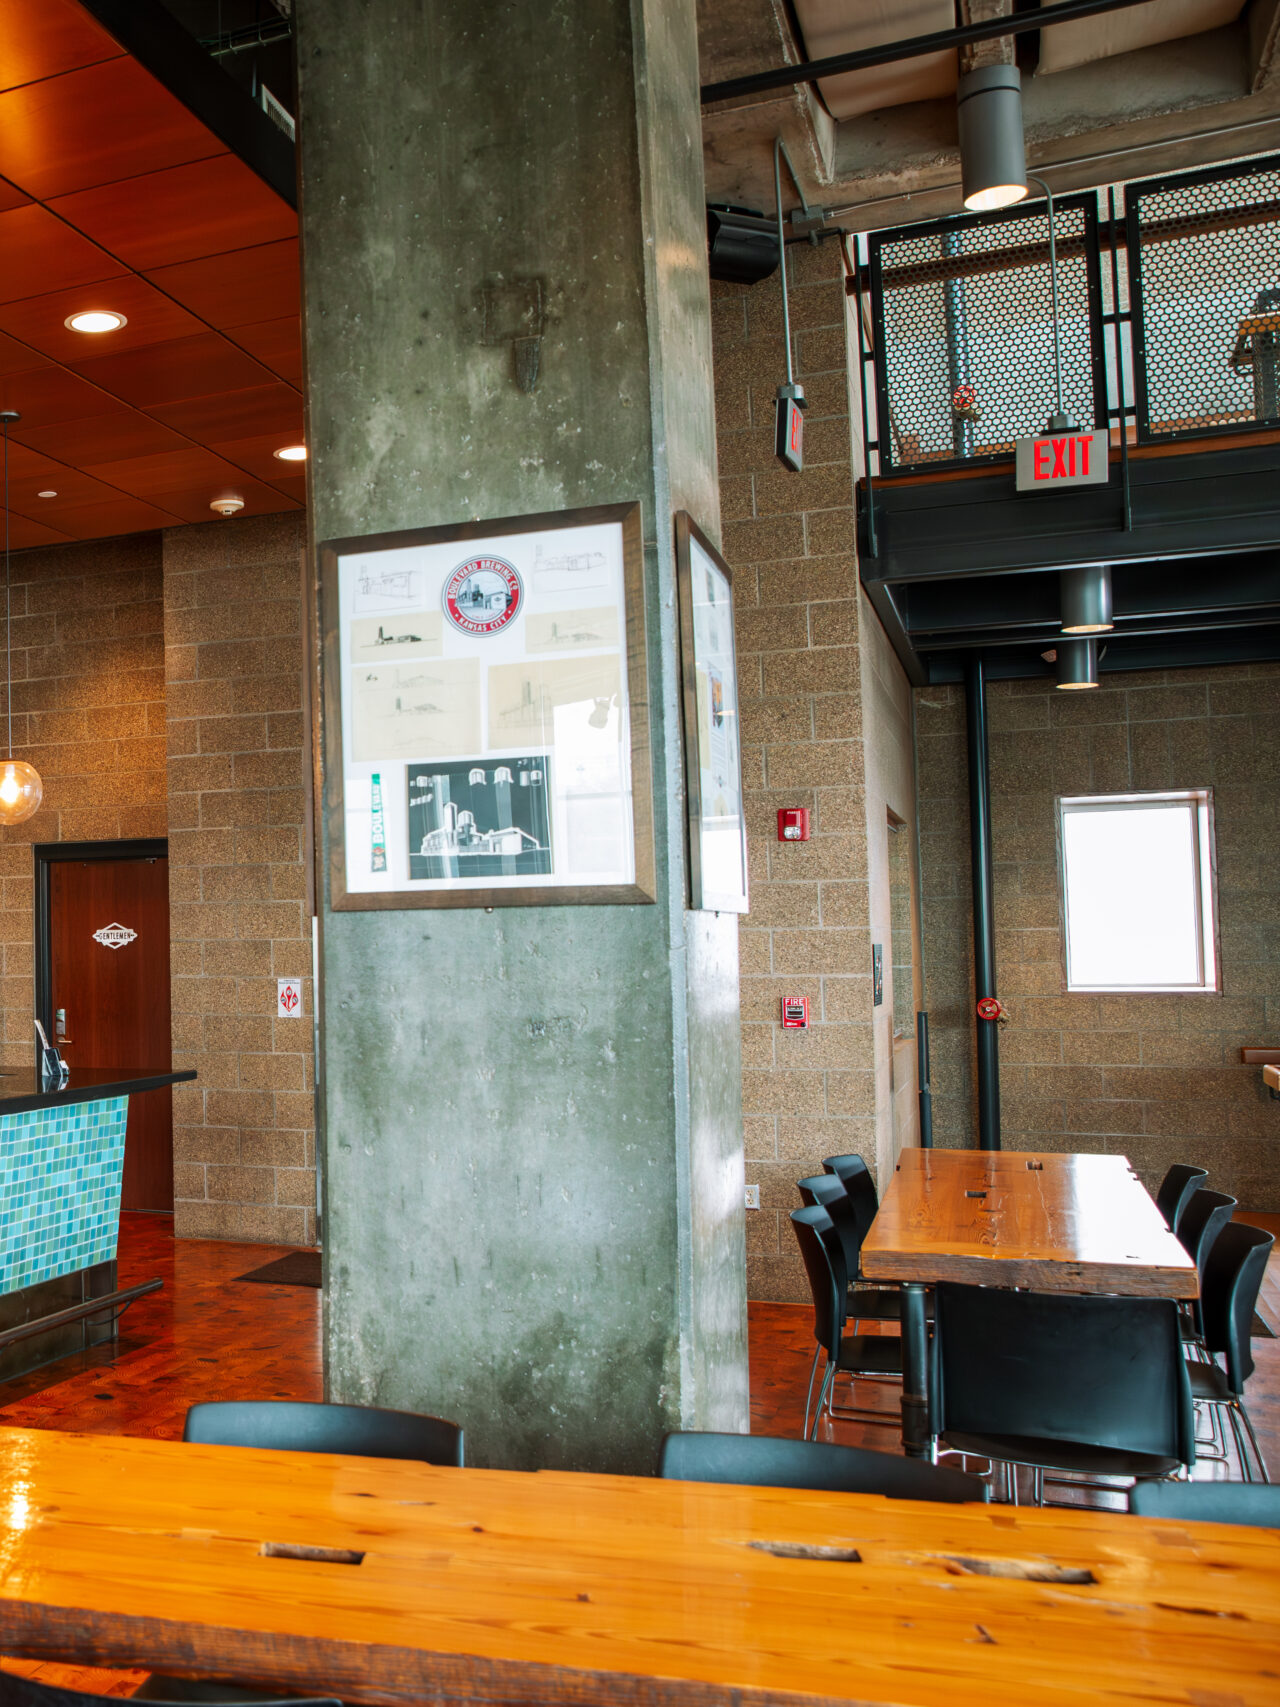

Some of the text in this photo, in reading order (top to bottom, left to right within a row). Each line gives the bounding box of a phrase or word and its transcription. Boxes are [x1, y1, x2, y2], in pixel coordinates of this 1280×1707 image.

[1033, 435, 1094, 481] EXIT
[448, 562, 478, 599] BOULEVARD
[481, 560, 513, 580] BREWING
[459, 618, 487, 632] KANSAS
[490, 615, 507, 628] CITY
[99, 932, 131, 940] GENTLEMEN
[785, 998, 804, 1006] FIRE
